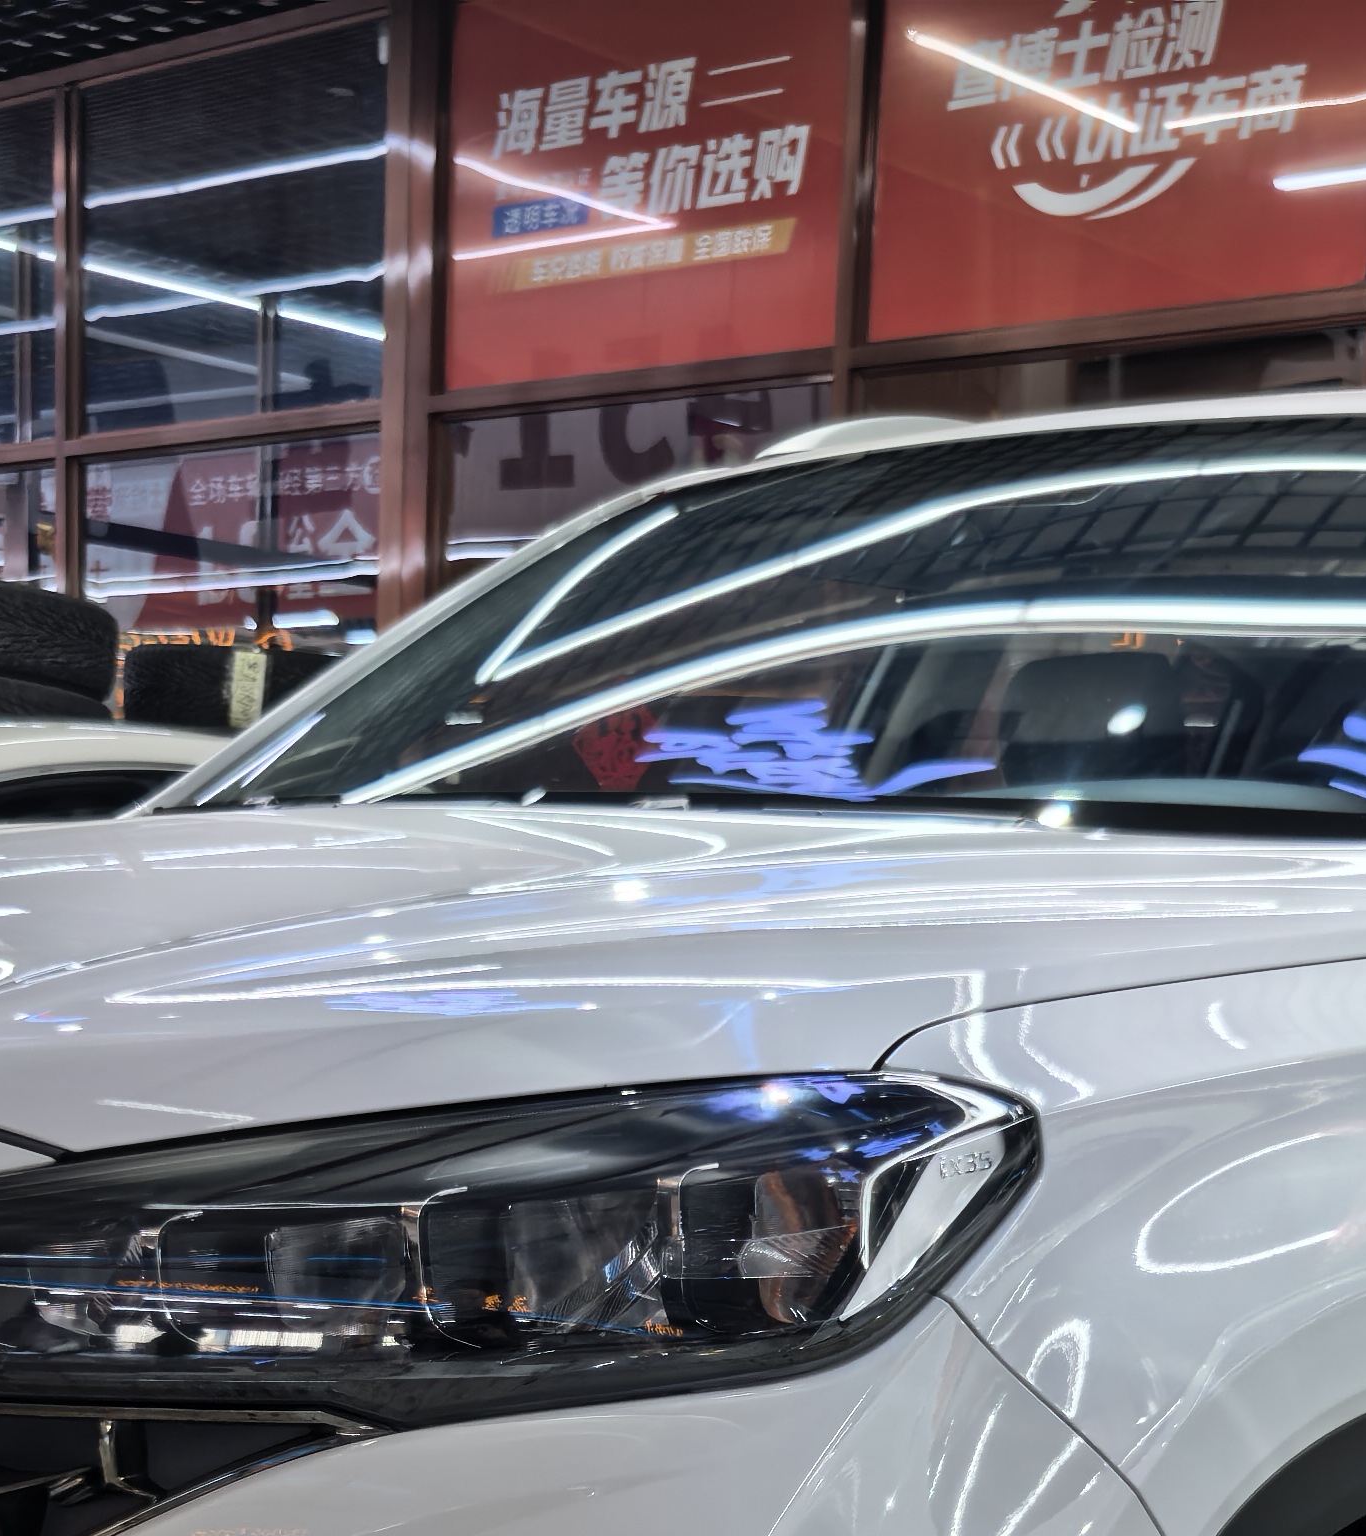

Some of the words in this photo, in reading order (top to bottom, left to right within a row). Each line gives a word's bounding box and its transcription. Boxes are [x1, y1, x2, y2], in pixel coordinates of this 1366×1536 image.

[492, 56, 697, 160] 海量车源
[1073, 63, 1308, 166] 认证车商
[596, 124, 811, 217] 等你选购
